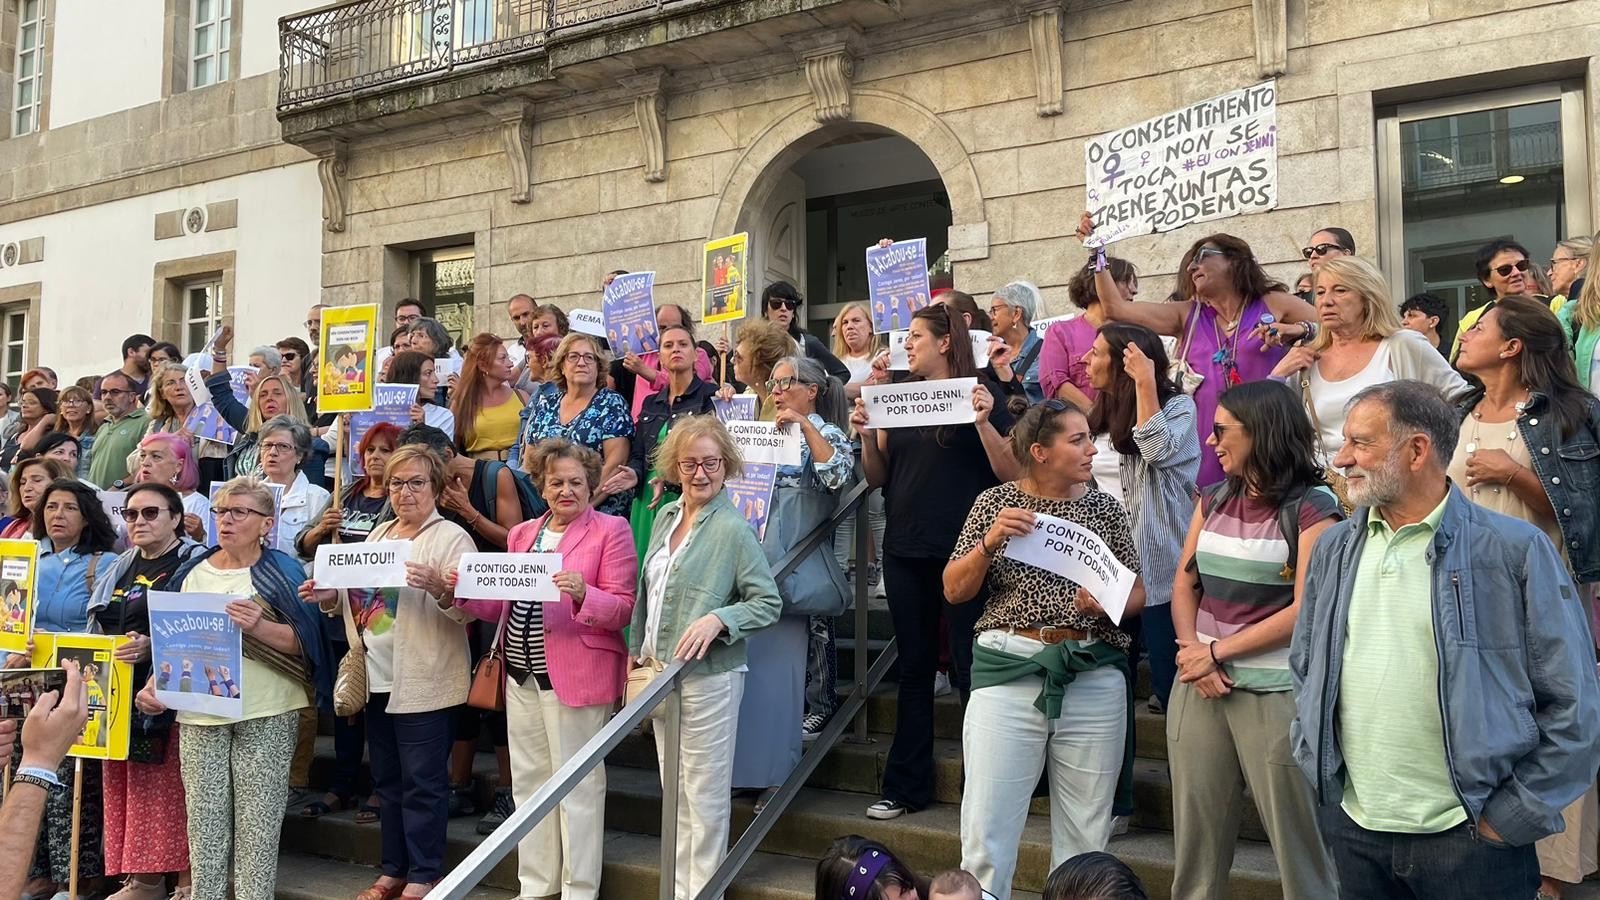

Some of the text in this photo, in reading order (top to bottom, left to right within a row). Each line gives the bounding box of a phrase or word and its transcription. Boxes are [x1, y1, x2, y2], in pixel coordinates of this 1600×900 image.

[1165, 119, 1260, 162] NON SE
[1088, 142, 1103, 163] O
[1182, 153, 1211, 171] #EU
[1214, 145, 1241, 160] CON
[1117, 166, 1178, 195] TOCA
[1091, 158, 1268, 229] IRENE XUNTAS
[1145, 184, 1272, 229] PODEMOS
[873, 390, 964, 404] # CONTIGO JENNI,
[886, 403, 953, 415] POR TODAS!!
[733, 425, 767, 436] CONTIGO
[768, 426, 793, 437] JENNI,
[736, 437, 785, 448] POR TODAS!!
[328, 551, 395, 566] REMATOU!!
[1034, 520, 1120, 583] # CONTIGO JENNI,
[1044, 538, 1110, 587] POR TODAS!!
[466, 563, 549, 576] # CONTIGO JENNI,
[476, 576, 537, 588] POR TODAS!!
[153, 613, 225, 639] #Acabou-se
